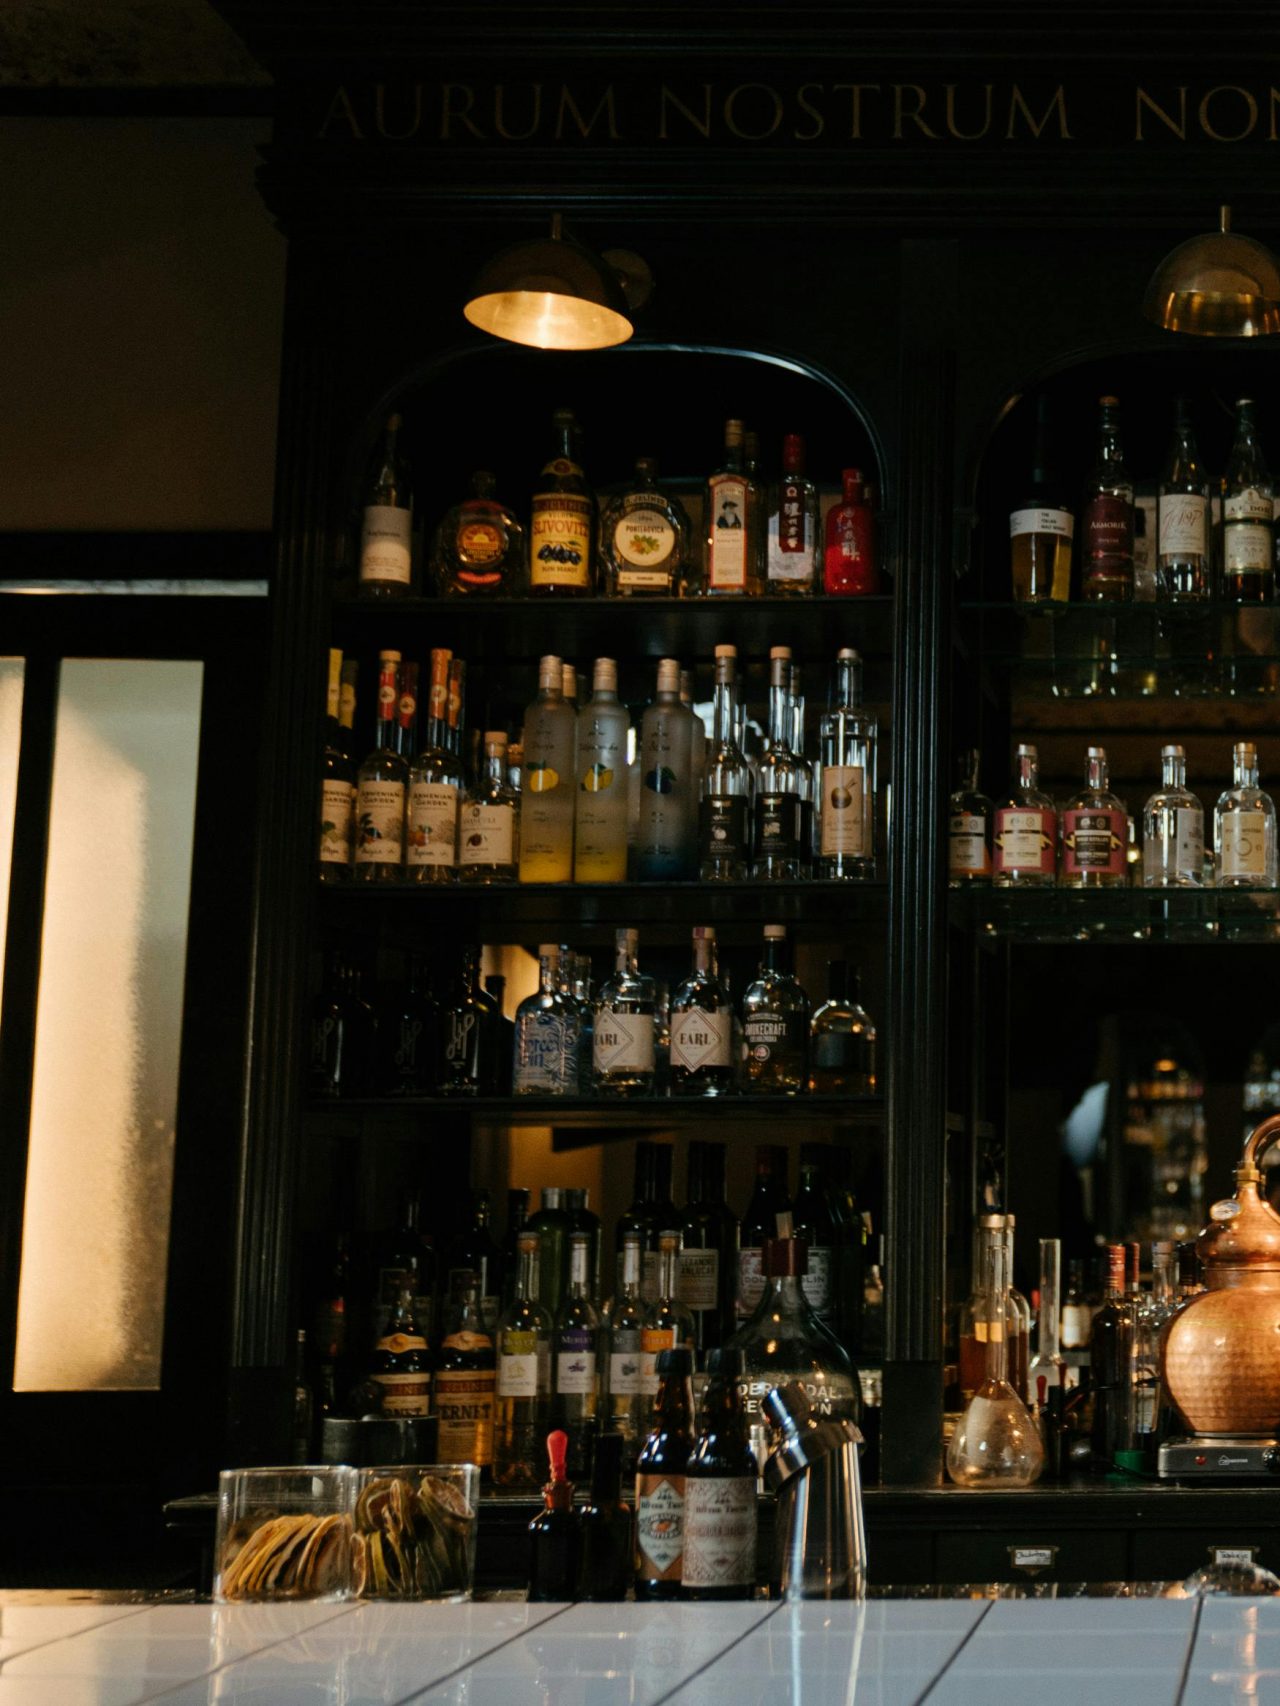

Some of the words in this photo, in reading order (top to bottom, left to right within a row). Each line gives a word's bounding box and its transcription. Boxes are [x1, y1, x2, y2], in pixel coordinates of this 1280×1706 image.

[317, 83, 625, 140] AURUM
[656, 81, 1075, 141] NOSTRUM
[1090, 520, 1127, 530] ARMORIK
[680, 1032, 711, 1045] EARL
